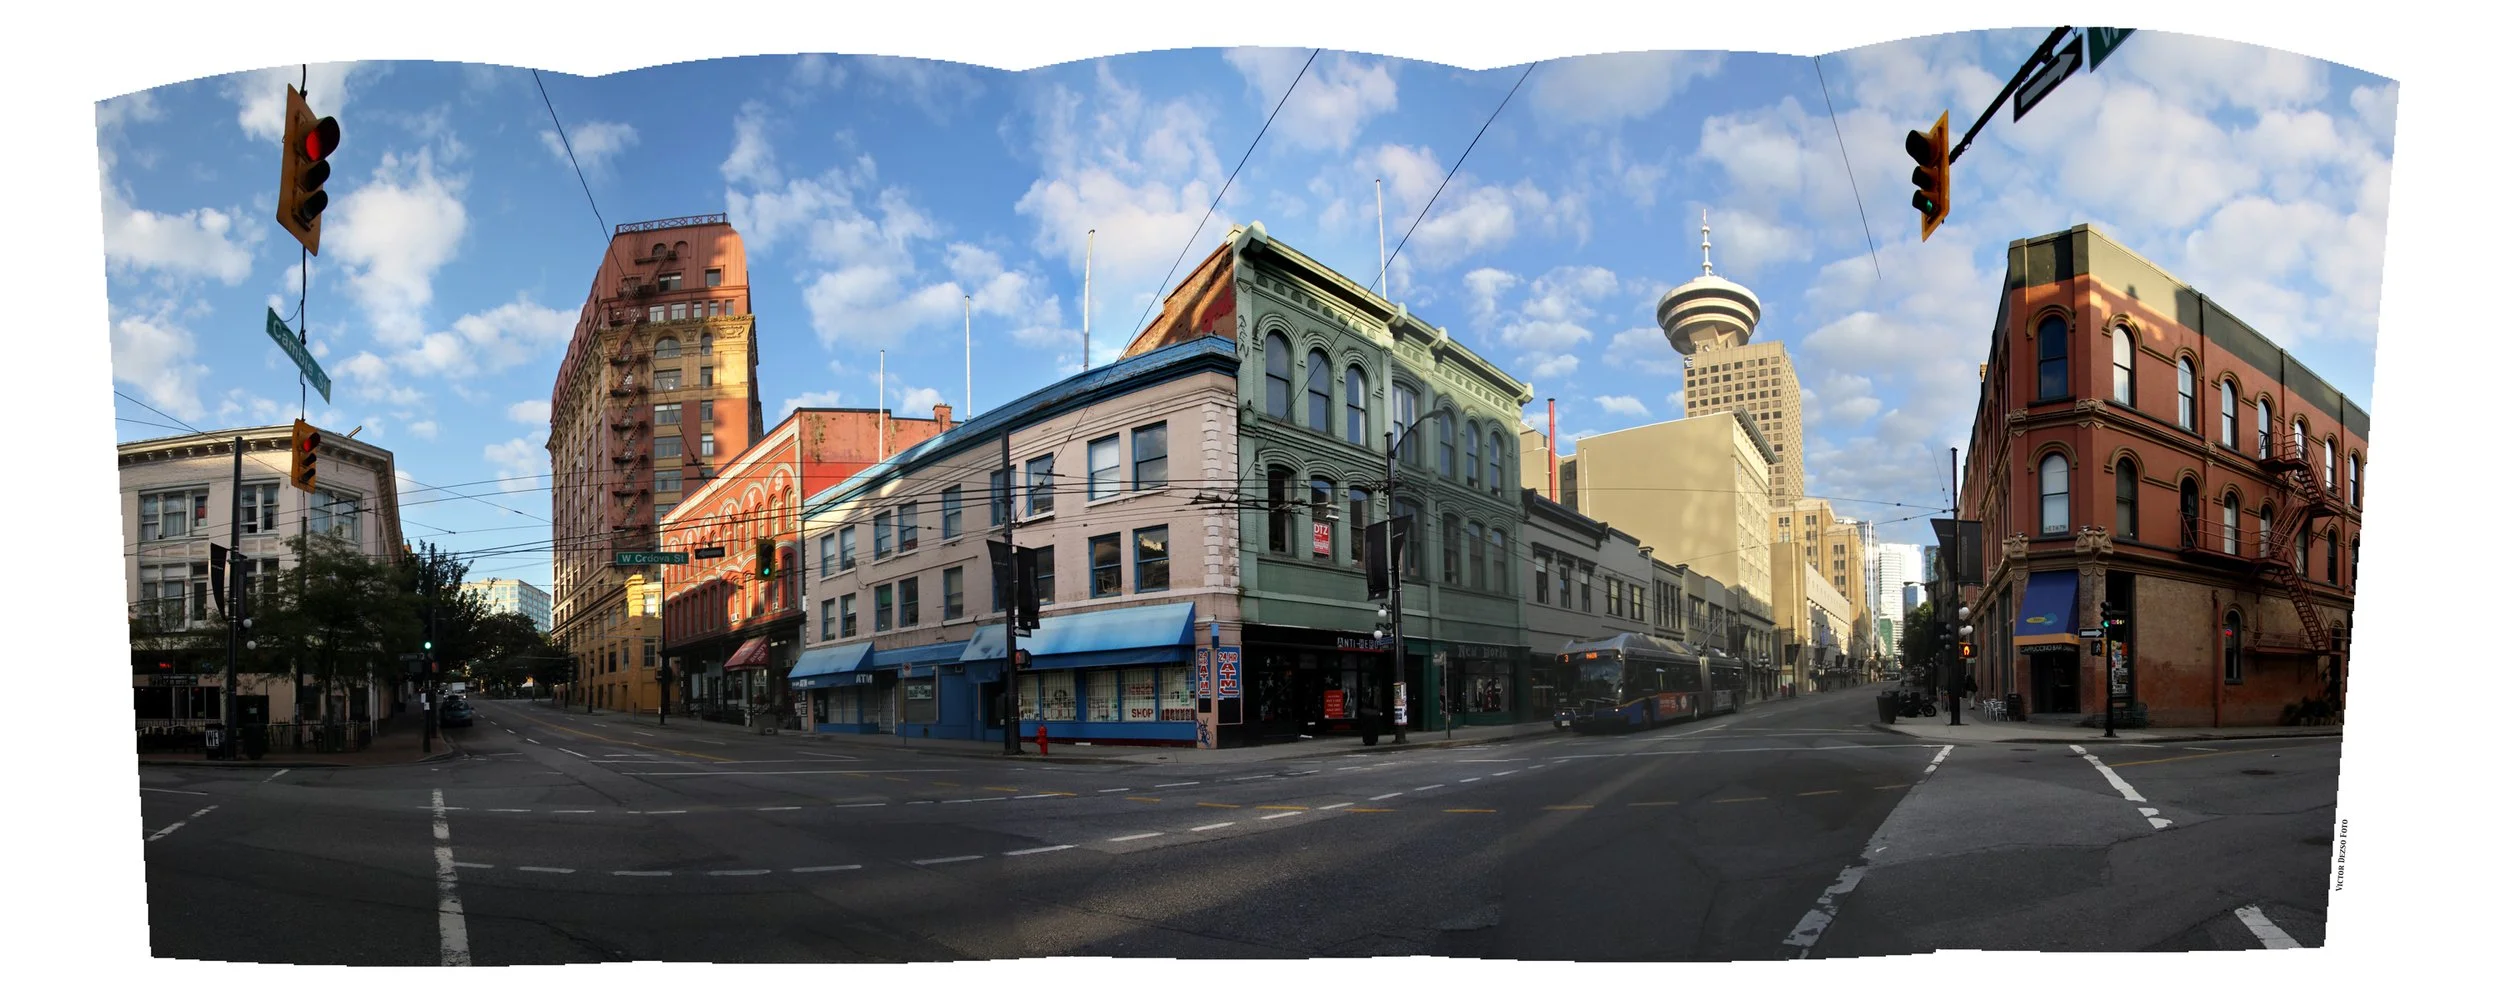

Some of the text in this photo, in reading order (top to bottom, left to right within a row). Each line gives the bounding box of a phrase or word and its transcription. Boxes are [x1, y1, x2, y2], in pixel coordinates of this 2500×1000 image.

[273, 320, 327, 394] Cambie St
[1314, 523, 1328, 536] DTZ
[621, 554, 631, 562] W
[673, 554, 685, 563] St
[1218, 652, 1238, 663] 24 HR
[1563, 654, 1569, 664] 3
[855, 674, 873, 684] ATM
[1219, 662, 1237, 689] ATM
[1131, 708, 1154, 718] SHOP
